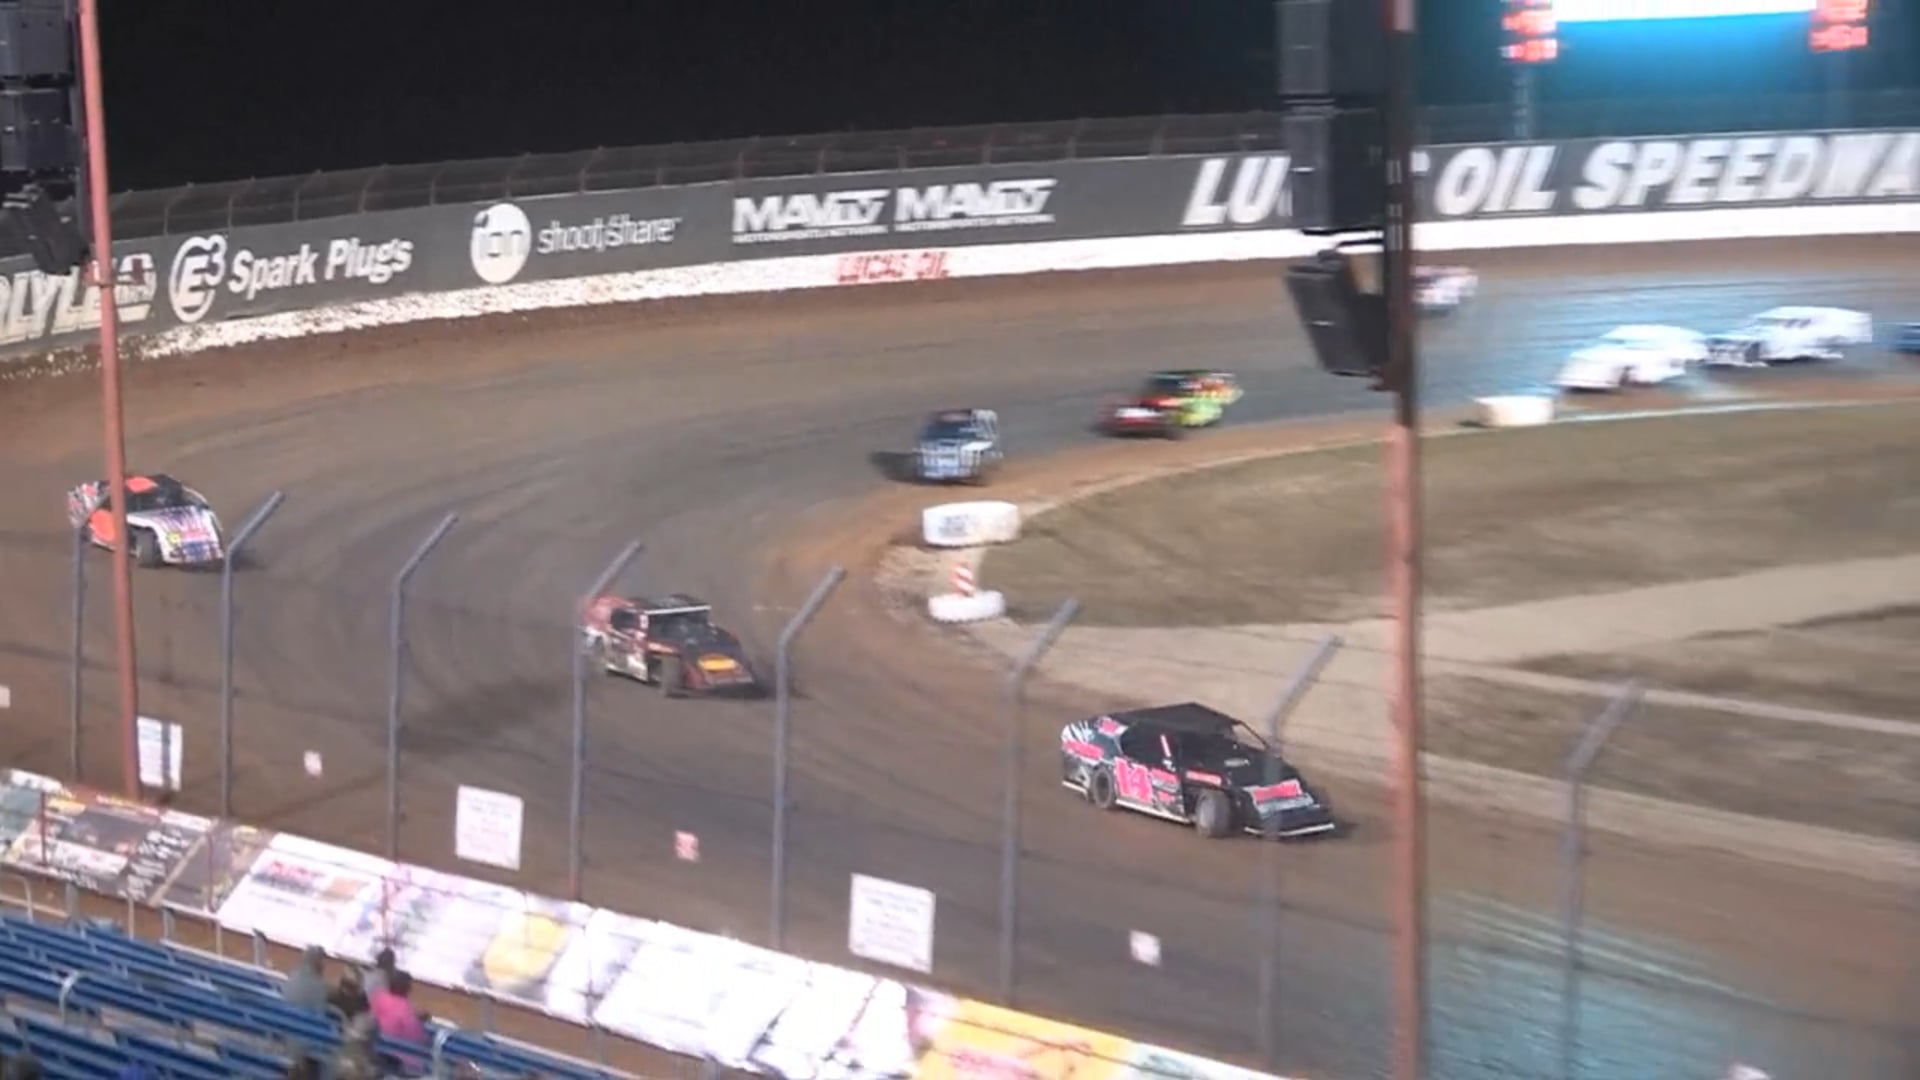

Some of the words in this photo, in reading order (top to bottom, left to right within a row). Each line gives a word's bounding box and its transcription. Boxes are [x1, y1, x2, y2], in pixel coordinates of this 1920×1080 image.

[1434, 144, 1558, 216] OIL
[228, 244, 319, 300] Spark
[324, 237, 413, 284] Plugs
